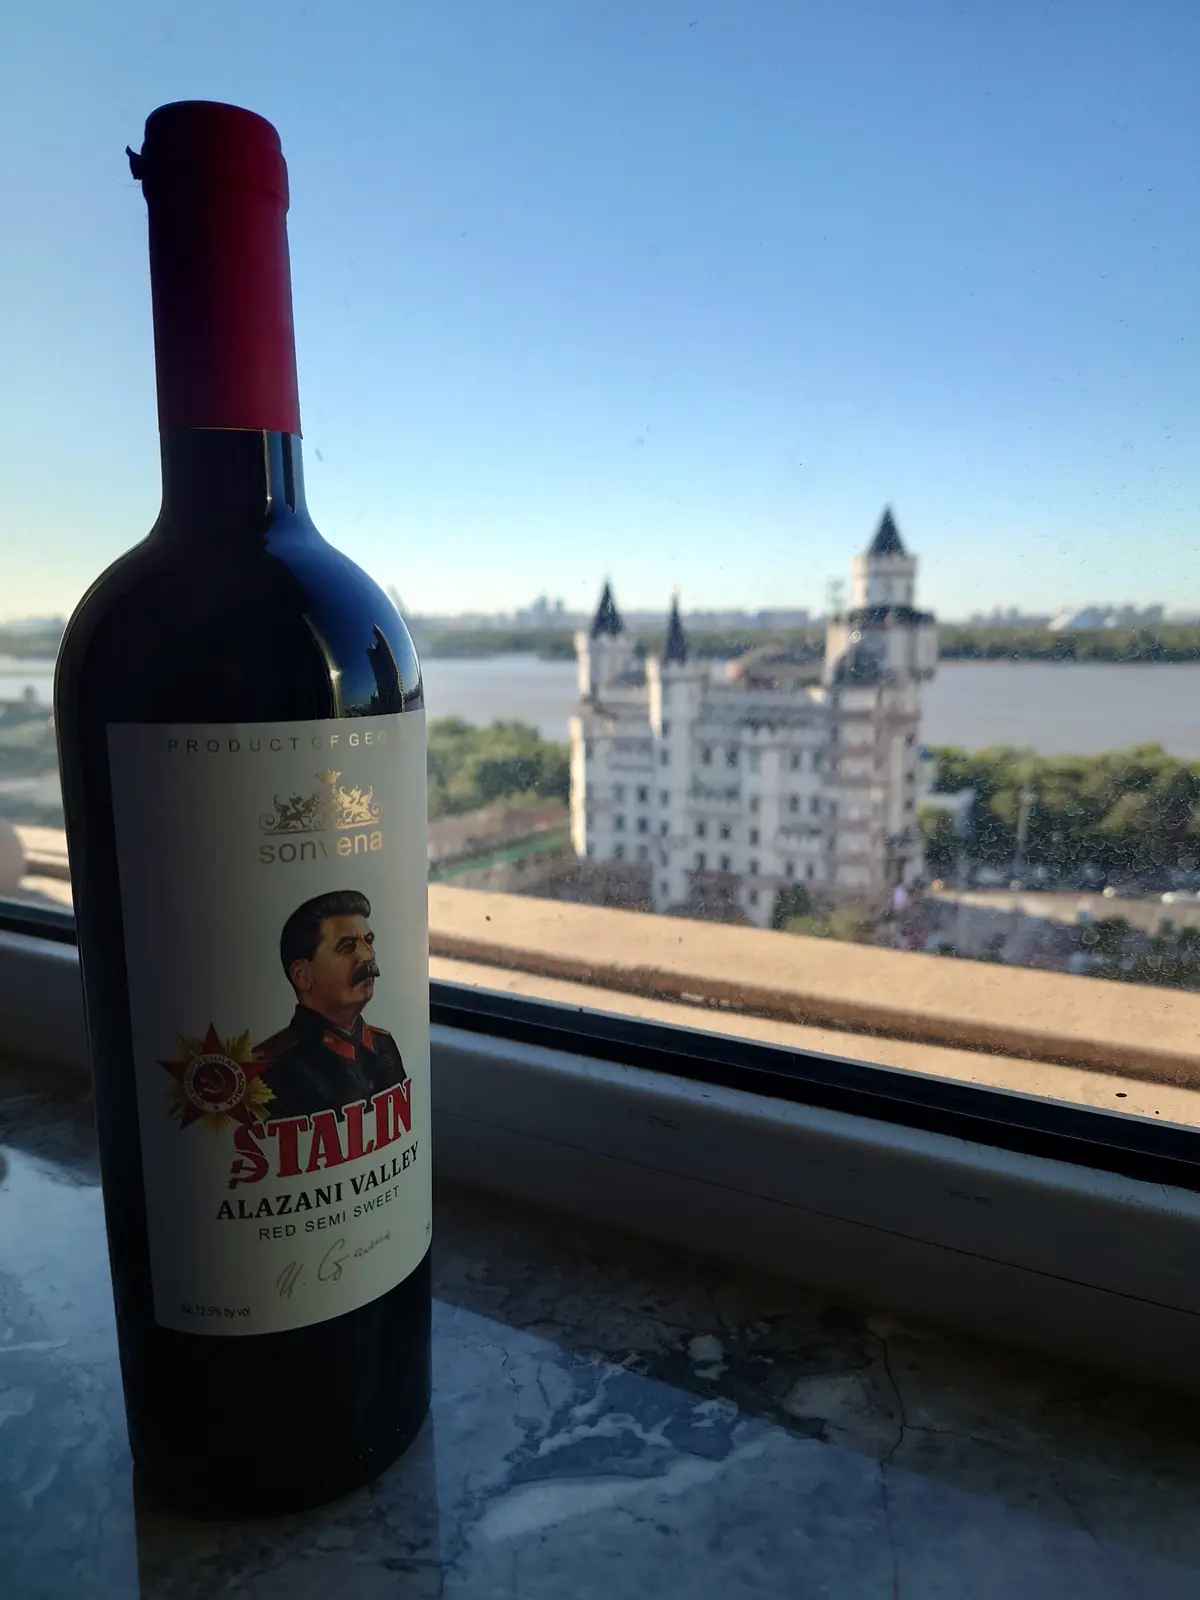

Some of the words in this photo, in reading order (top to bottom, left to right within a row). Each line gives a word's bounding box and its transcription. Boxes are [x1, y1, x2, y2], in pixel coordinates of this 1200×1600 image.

[168, 738, 299, 753] PRODUCT
[311, 734, 340, 750] OF
[259, 831, 383, 864] sonvena
[227, 1078, 413, 1190] STALIN
[216, 1182, 343, 1220] ALAZANI
[350, 1141, 419, 1197] VALLEY
[258, 1224, 296, 1241] RED
[305, 1213, 346, 1234] SEMI
[353, 1185, 400, 1218] SWEET
[224, 1307, 235, 1319] by
